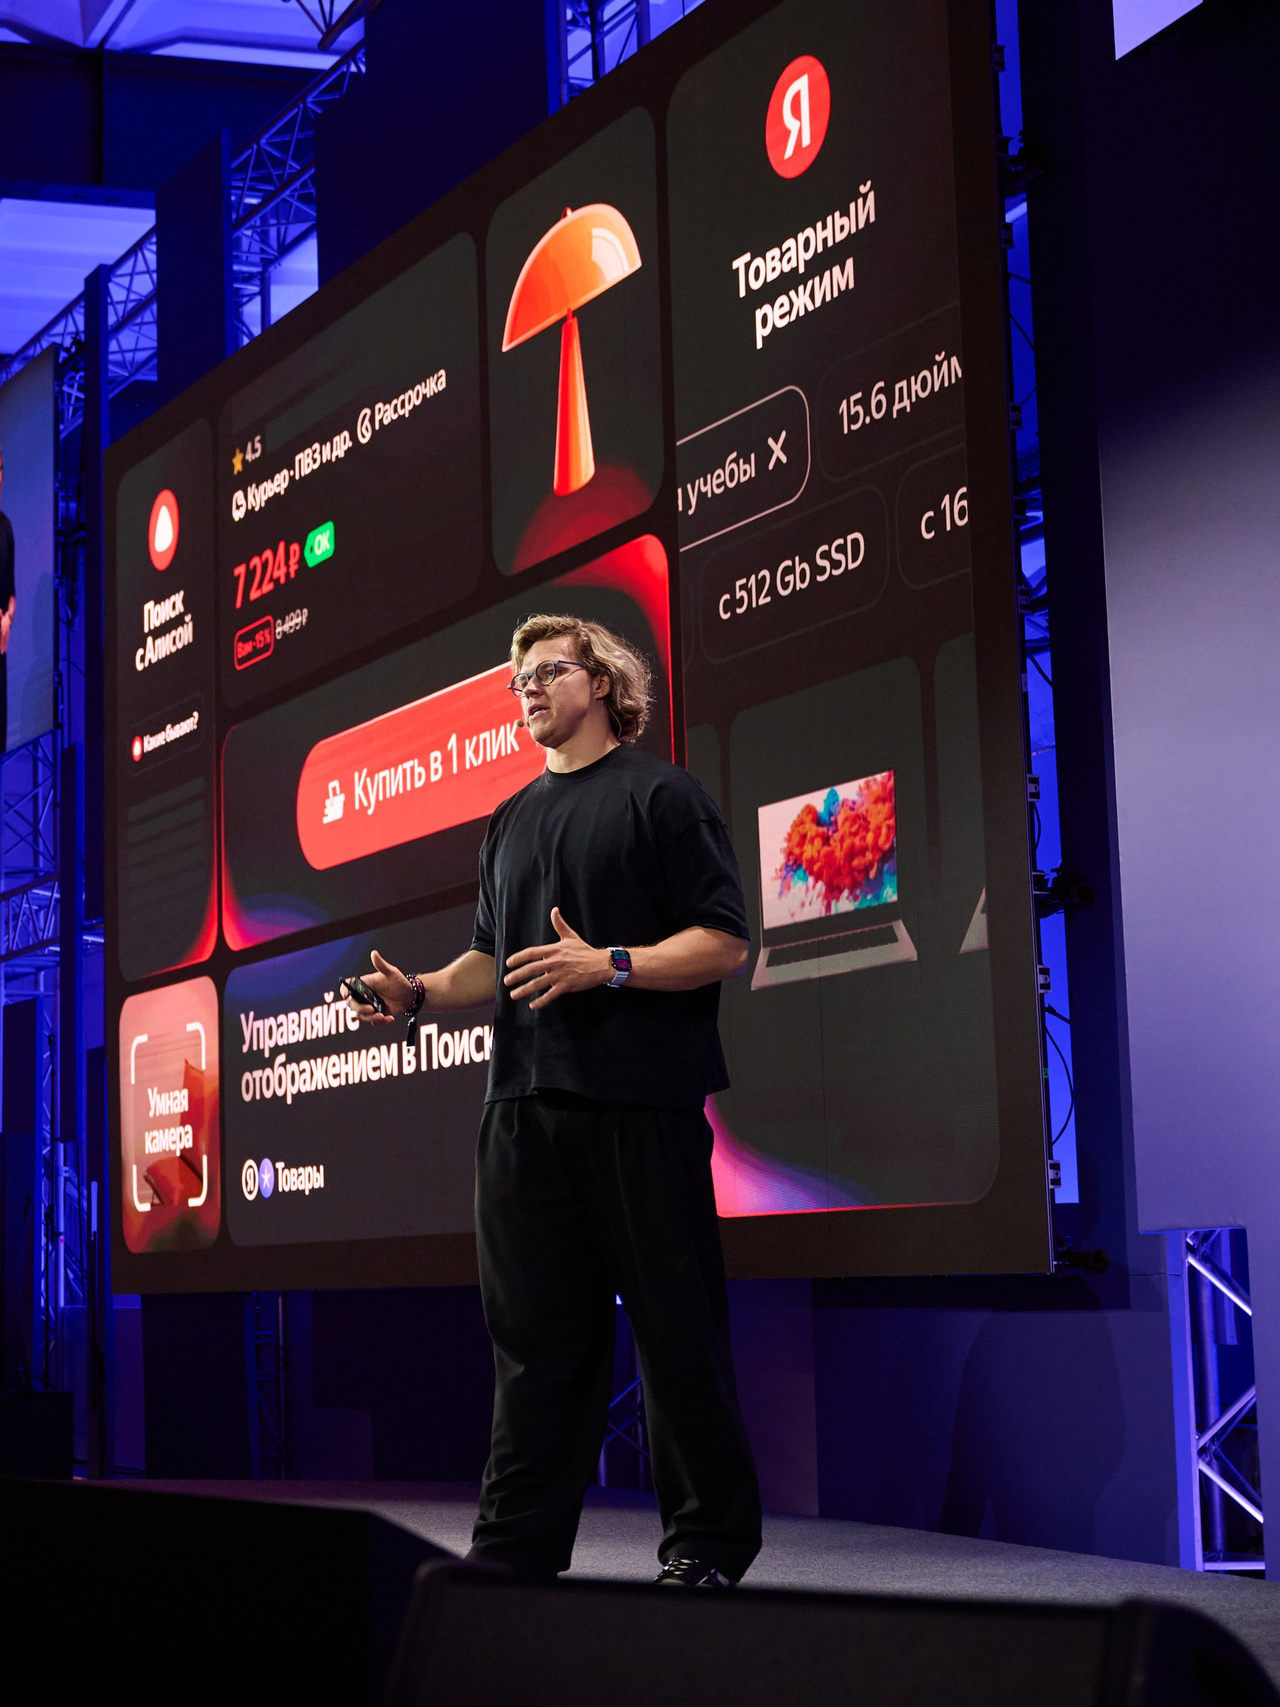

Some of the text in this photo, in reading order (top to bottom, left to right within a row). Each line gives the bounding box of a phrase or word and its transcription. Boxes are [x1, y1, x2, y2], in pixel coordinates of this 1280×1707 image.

[782, 73, 811, 160] Я
[732, 180, 876, 298] Товарный
[755, 257, 855, 350] режим
[838, 381, 887, 434] 15.6
[245, 435, 261, 462] 4.5
[247, 369, 447, 512] Курьер ПВЗ и др. Рассрочка
[686, 451, 756, 516] учебы
[940, 486, 969, 532] 16
[735, 569, 772, 614] 512
[776, 555, 810, 597] Gb
[815, 531, 865, 583] SSD
[143, 590, 185, 633] Поиск
[144, 613, 194, 668] Алисой
[354, 719, 520, 815] Купить в 1 клик
[239, 991, 360, 1059] Управляйте
[147, 1087, 189, 1118] Умная
[241, 1041, 398, 1104] отображением
[402, 1040, 416, 1074] в
[145, 1123, 193, 1157] камера
[275, 1161, 325, 1196] Товары
